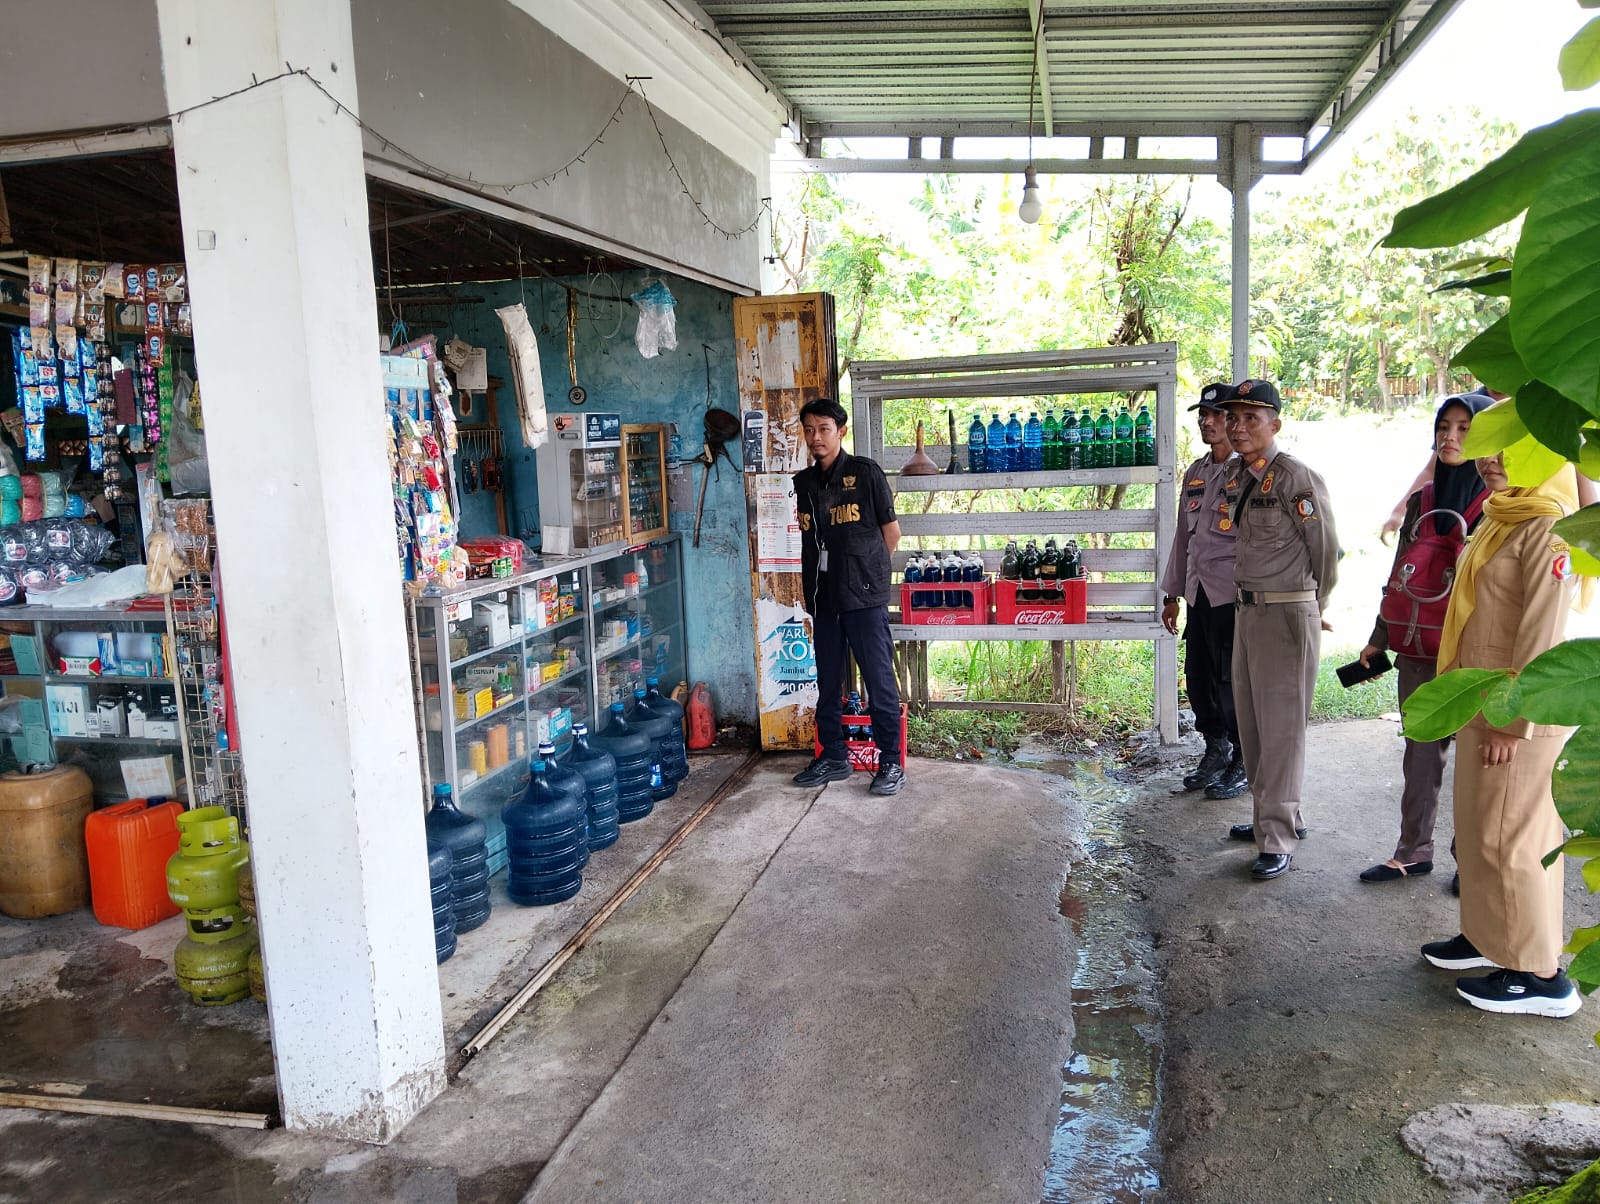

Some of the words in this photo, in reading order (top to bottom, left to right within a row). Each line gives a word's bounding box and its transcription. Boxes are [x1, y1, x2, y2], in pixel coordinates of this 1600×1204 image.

[161, 274, 178, 282] TOP
[830, 503, 861, 526] TOMS
[1014, 610, 1065, 625] Coca-Cola
[775, 628, 809, 639] WARU
[776, 640, 815, 661] KO
